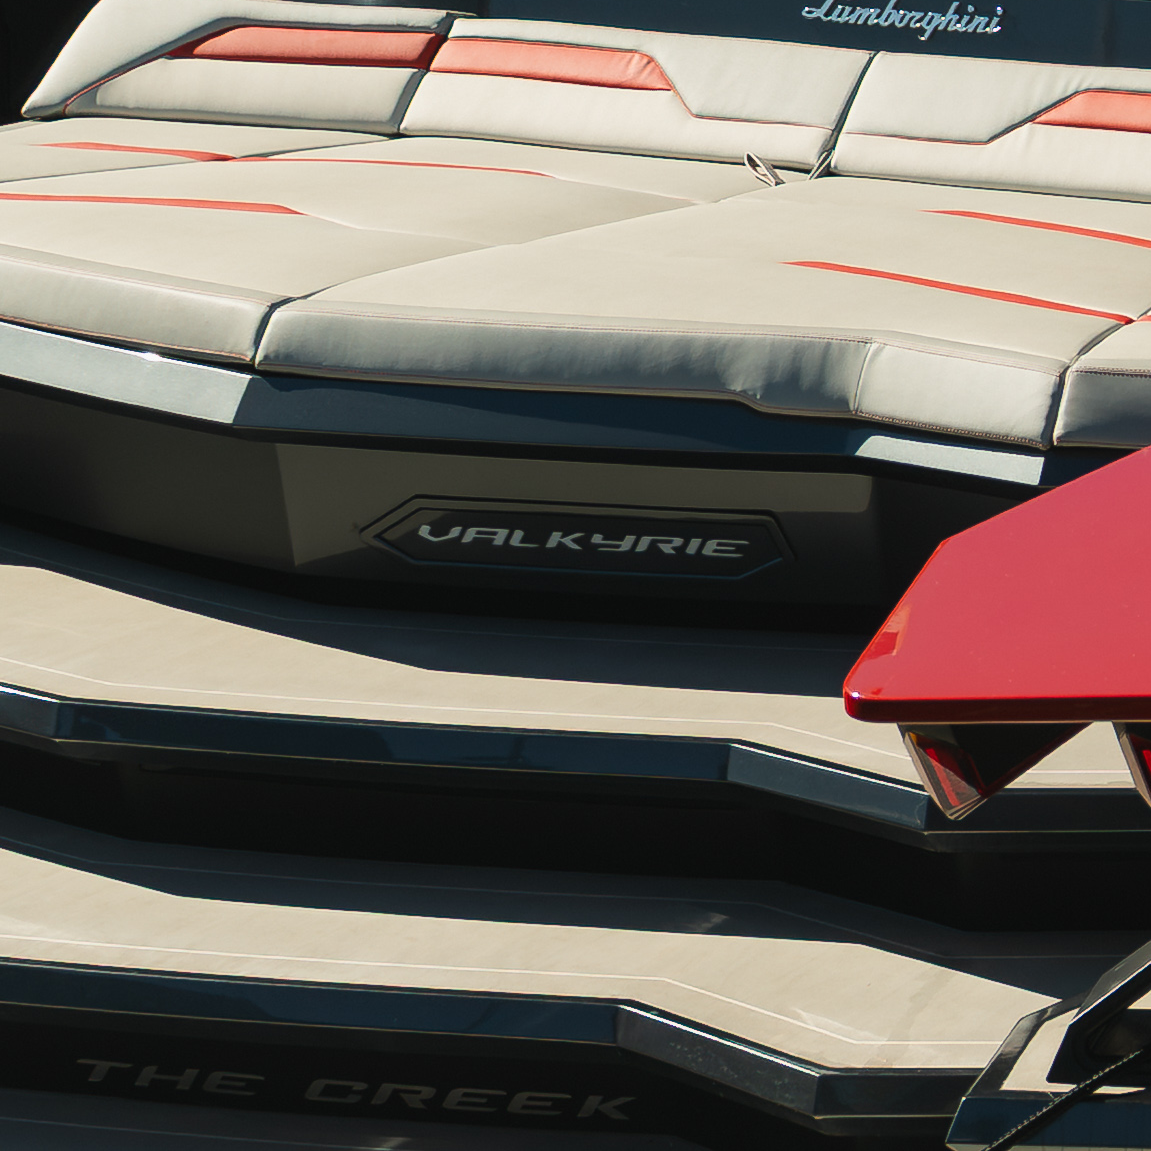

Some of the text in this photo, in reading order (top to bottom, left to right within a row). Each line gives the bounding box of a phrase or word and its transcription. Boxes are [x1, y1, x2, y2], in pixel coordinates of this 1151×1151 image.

[417, 524, 751, 558] VALKYRIE
[75, 1057, 638, 1121] THE CREEK
